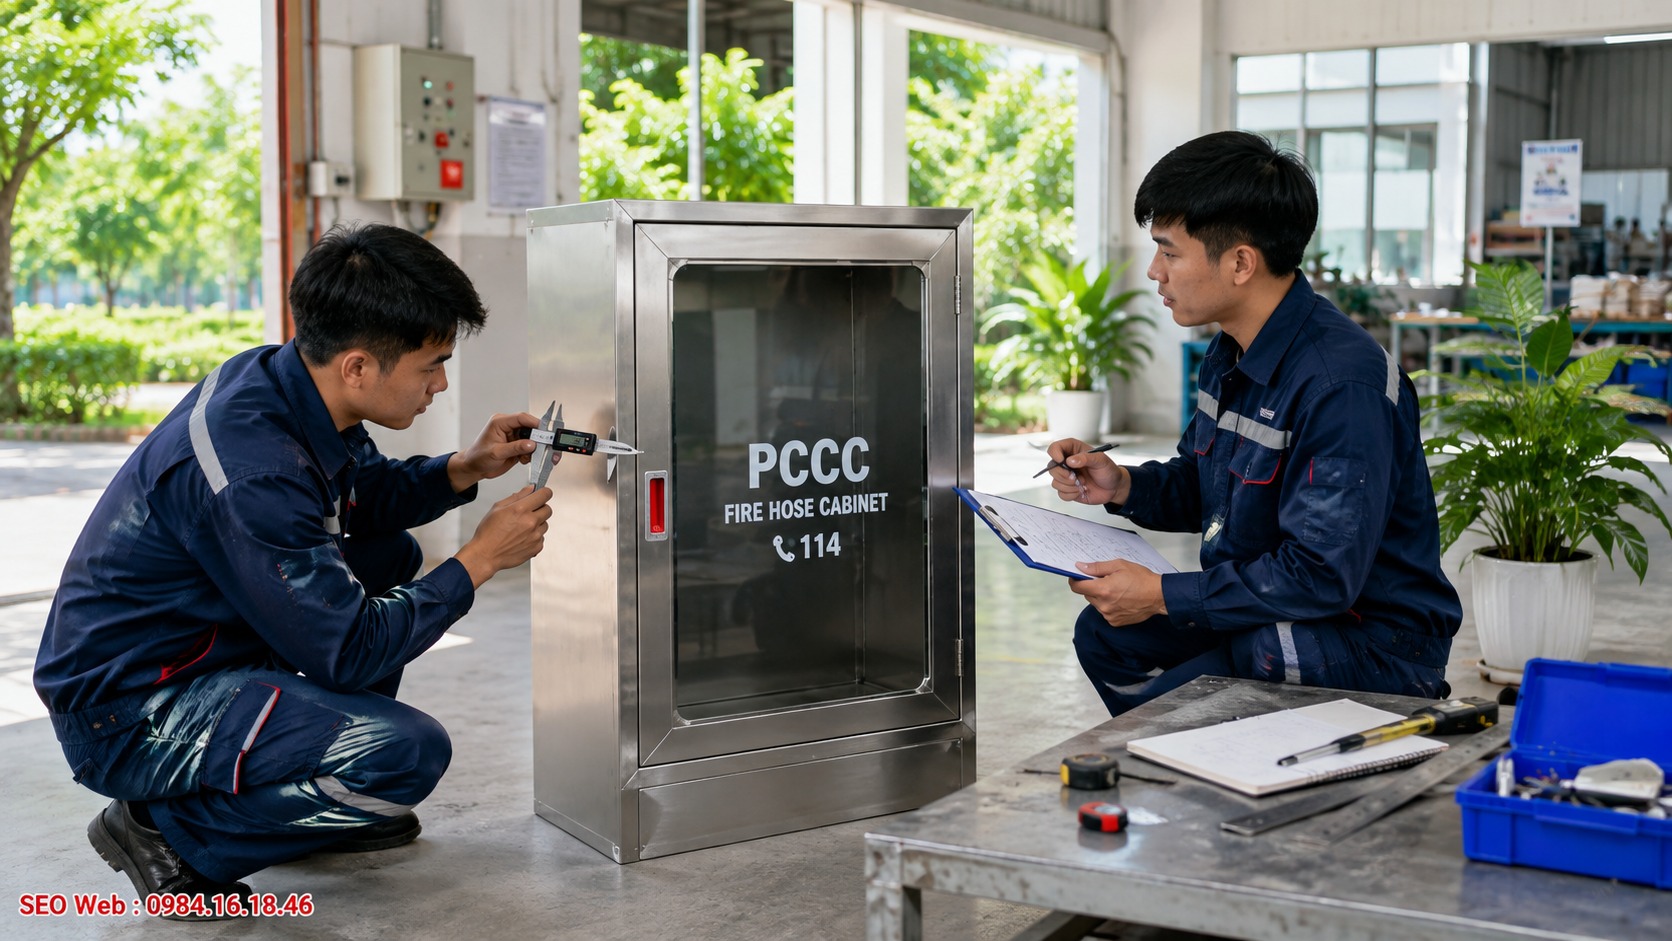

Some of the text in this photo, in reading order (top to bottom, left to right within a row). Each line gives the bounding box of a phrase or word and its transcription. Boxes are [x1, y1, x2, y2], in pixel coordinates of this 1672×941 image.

[748, 436, 870, 489] PCCC
[724, 492, 889, 524] FIRE HOSE CABINET
[800, 531, 841, 559] 114
